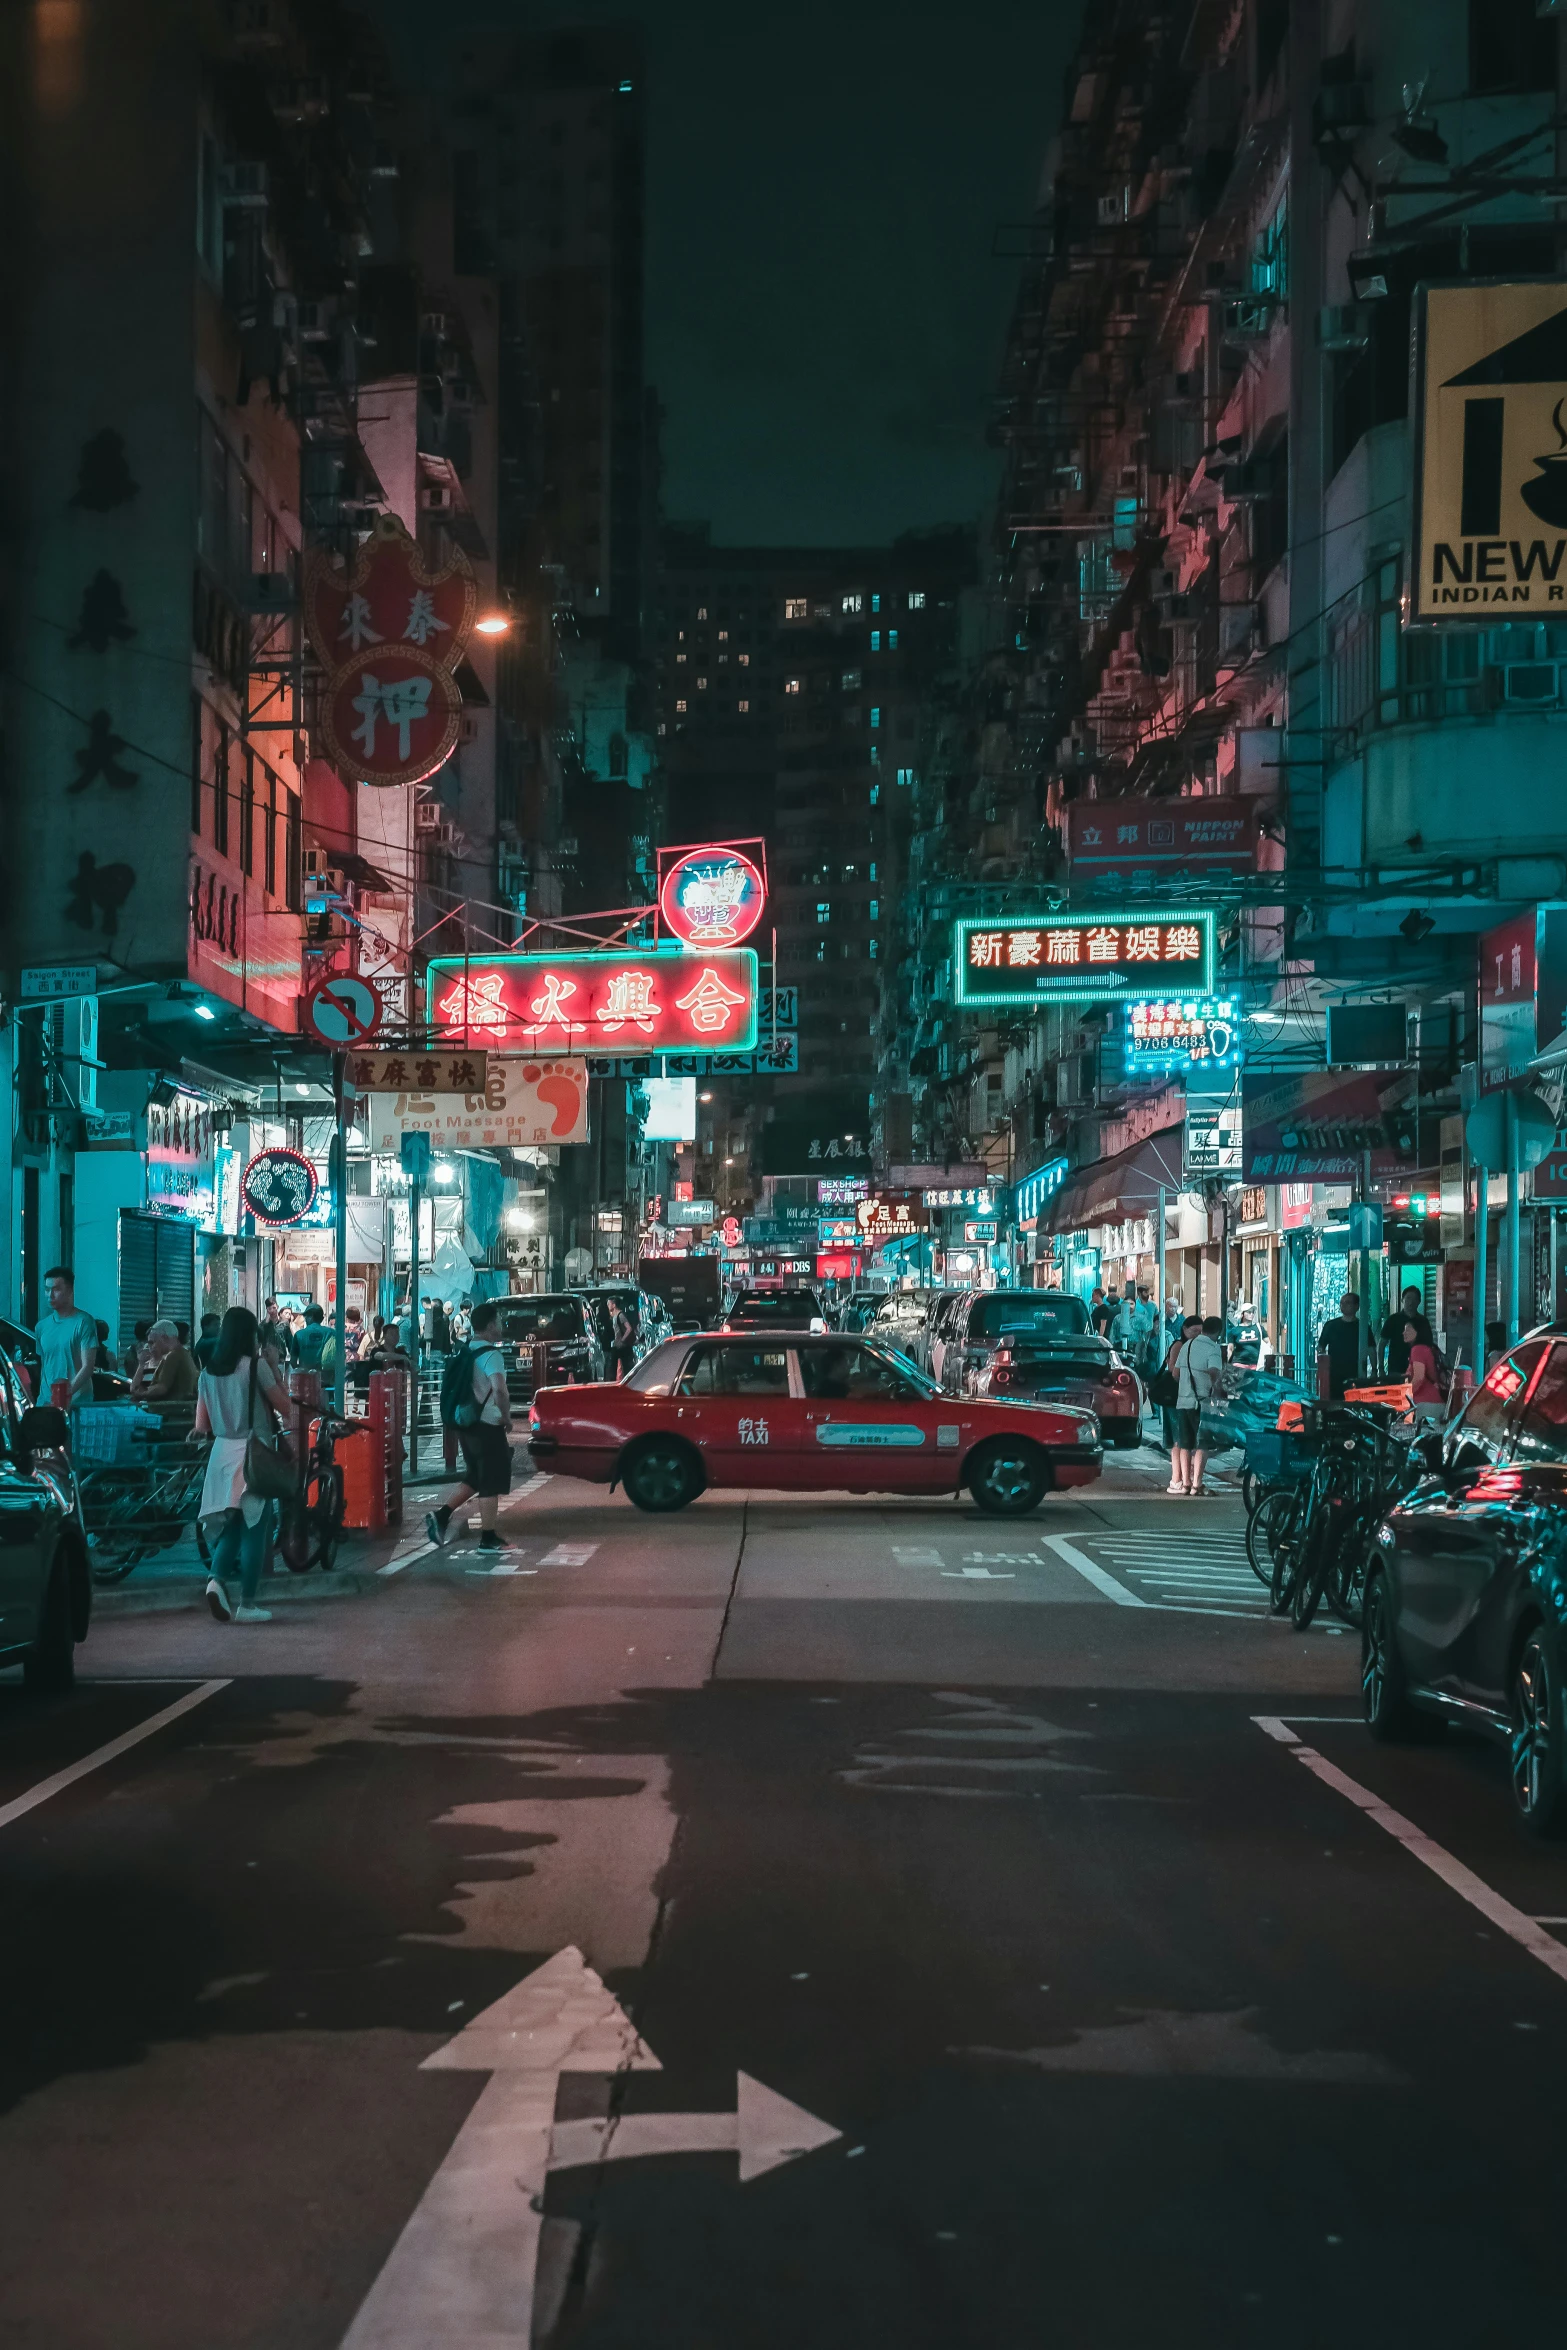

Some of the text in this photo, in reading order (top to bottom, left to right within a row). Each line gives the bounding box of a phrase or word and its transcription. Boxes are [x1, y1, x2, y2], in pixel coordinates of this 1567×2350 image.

[1433, 540, 1567, 584] NEW
[1432, 586, 1530, 604] INDIAN
[351, 672, 433, 761] 押
[1184, 820, 1245, 832] NIPPON
[1081, 824, 1139, 846] 立邦
[1190, 831, 1239, 842] PAINT
[27, 969, 91, 980] Saigon Street
[1494, 943, 1522, 997] 工商
[1172, 1035, 1207, 1049] 6483
[1189, 1047, 1211, 1061] 1/F
[401, 1114, 526, 1130] Foot Massage
[381, 1127, 548, 1149] 足按摩專門店
[821, 1180, 866, 1188] SEX SHOP
[793, 1261, 811, 1273] DBS
[738, 1417, 769, 1431] 的士
[739, 1430, 769, 1445] TAXI
